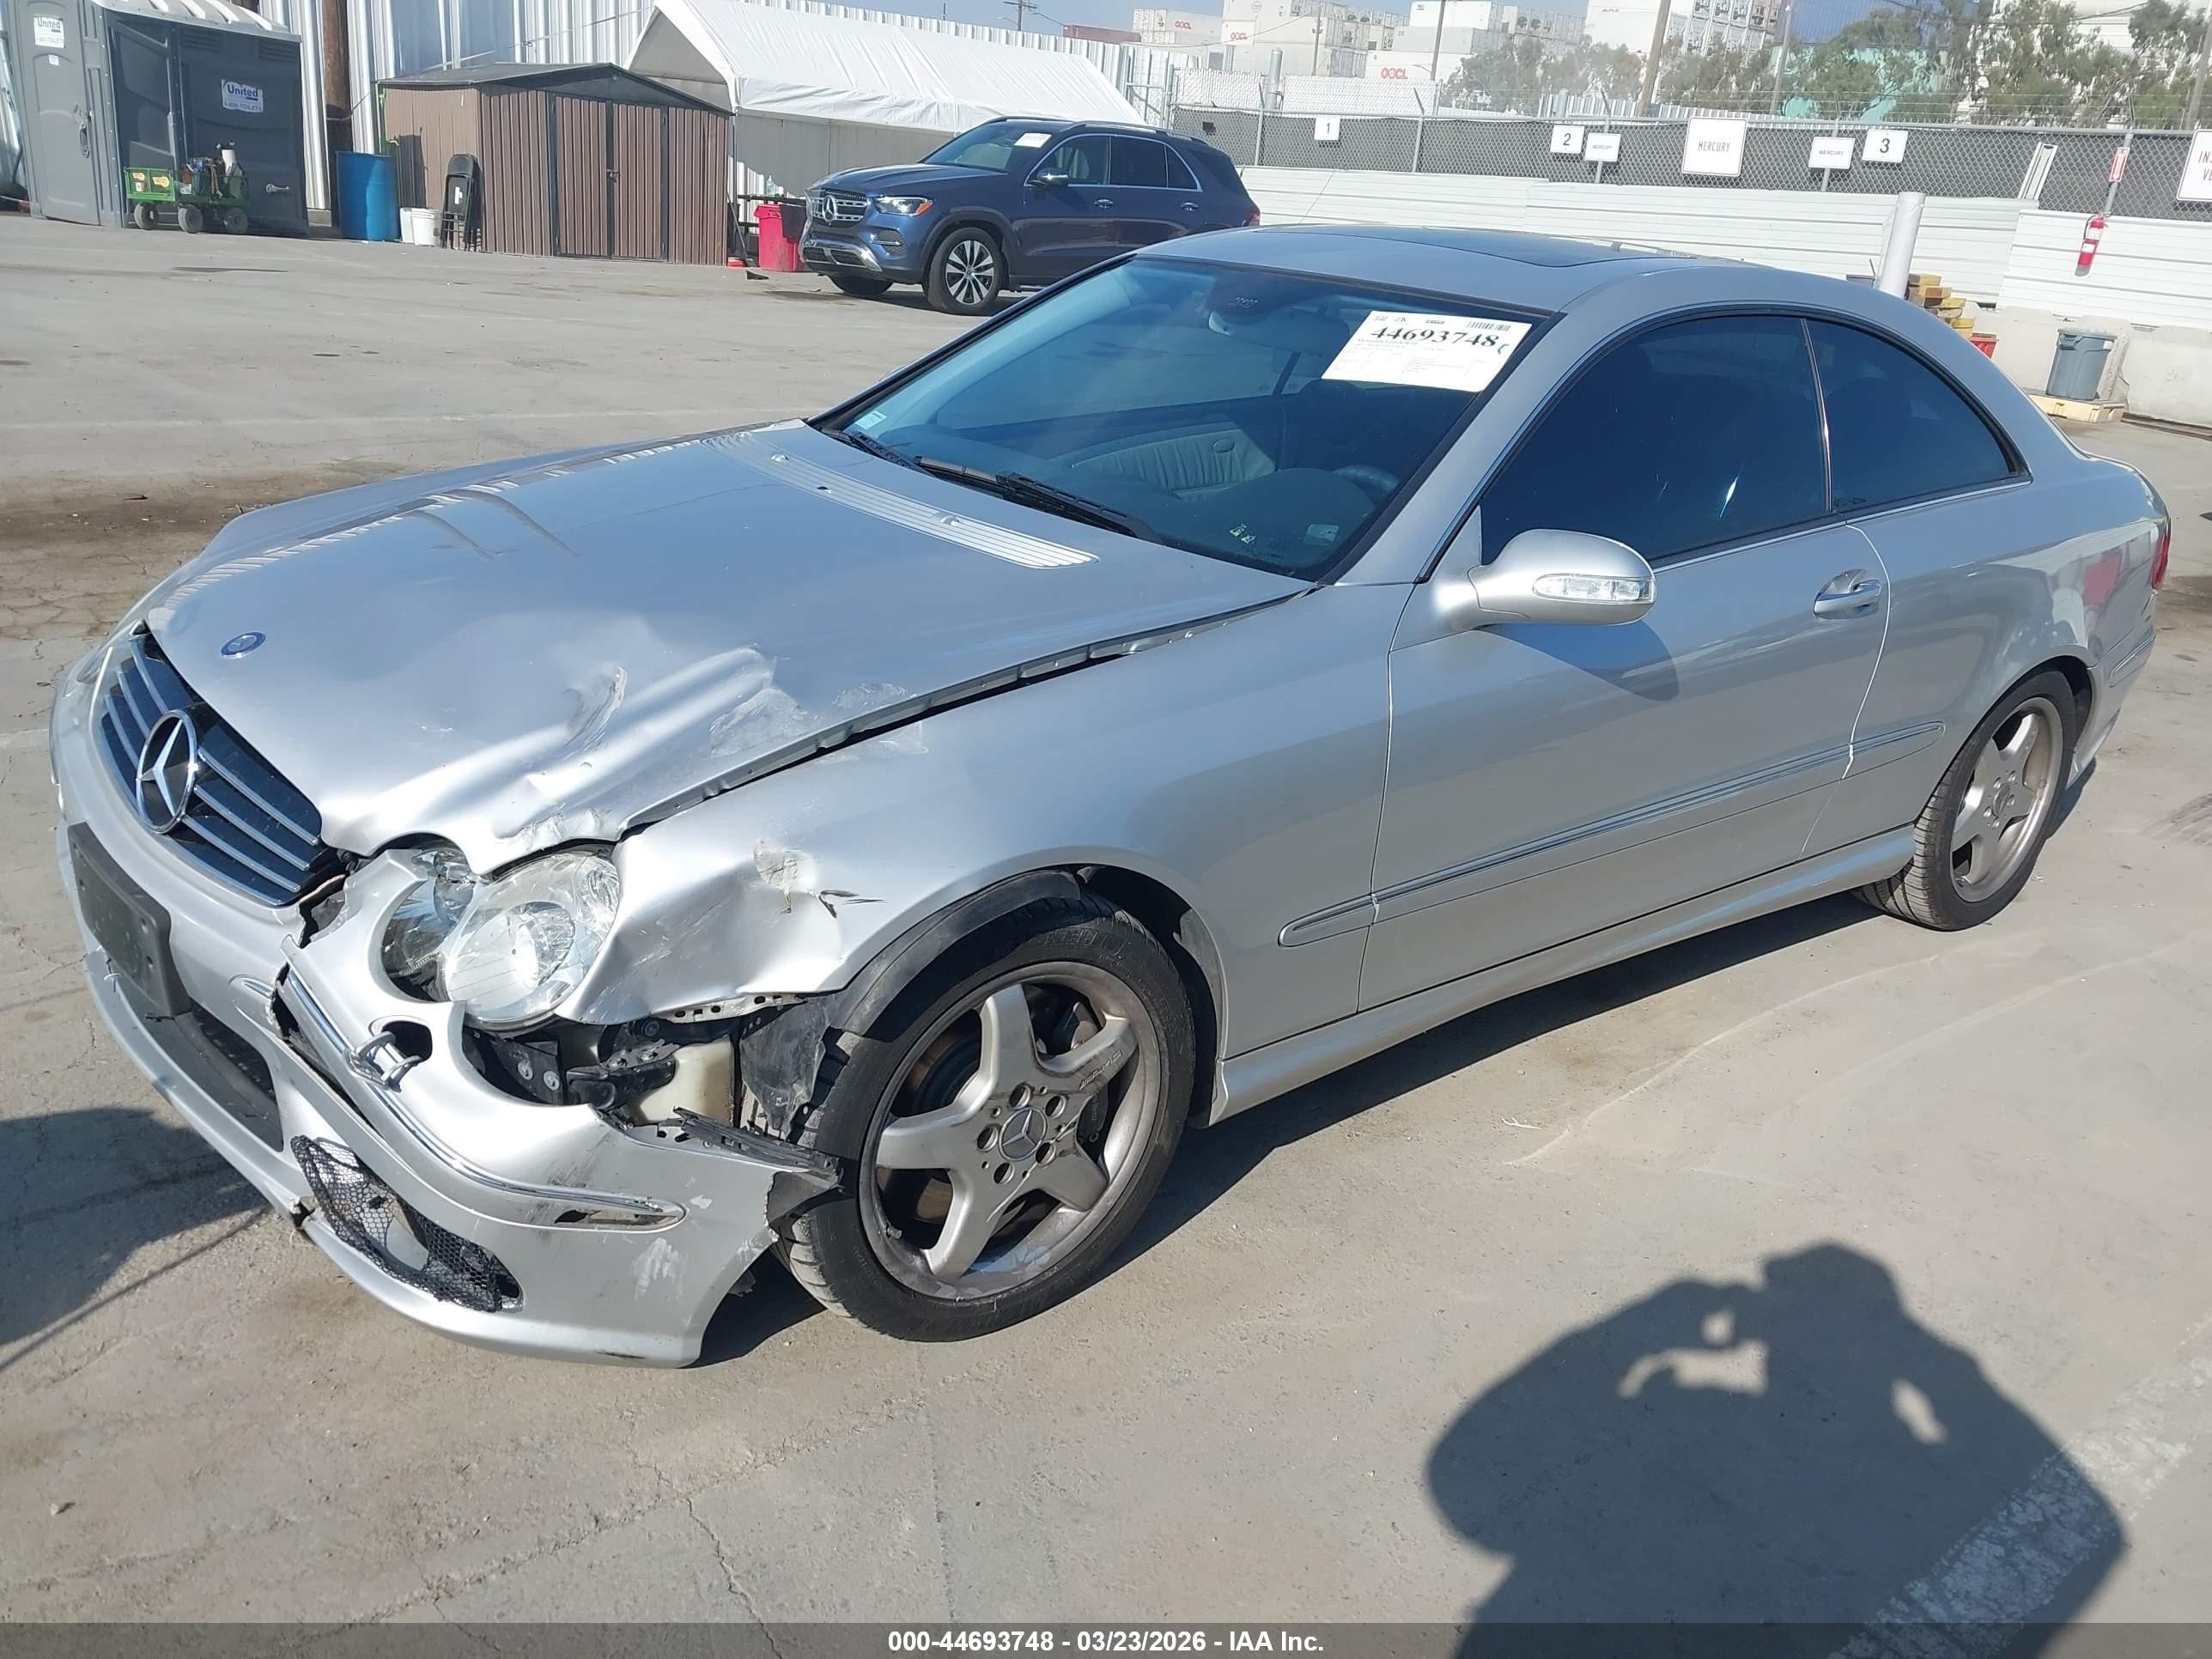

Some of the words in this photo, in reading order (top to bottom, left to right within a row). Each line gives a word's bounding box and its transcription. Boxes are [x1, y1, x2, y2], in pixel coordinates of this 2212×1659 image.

[37, 17, 61, 28] United
[1175, 21, 1192, 29] OOCL
[1231, 32, 1247, 40] OOCL
[1381, 67, 1408, 79] OOCL
[227, 83, 258, 97] United
[1326, 123, 1331, 134] 1
[1563, 132, 1571, 146] 2
[1698, 140, 1731, 152] MERCURY
[1880, 138, 1890, 153] 3
[1370, 326, 1499, 347] 44693748
